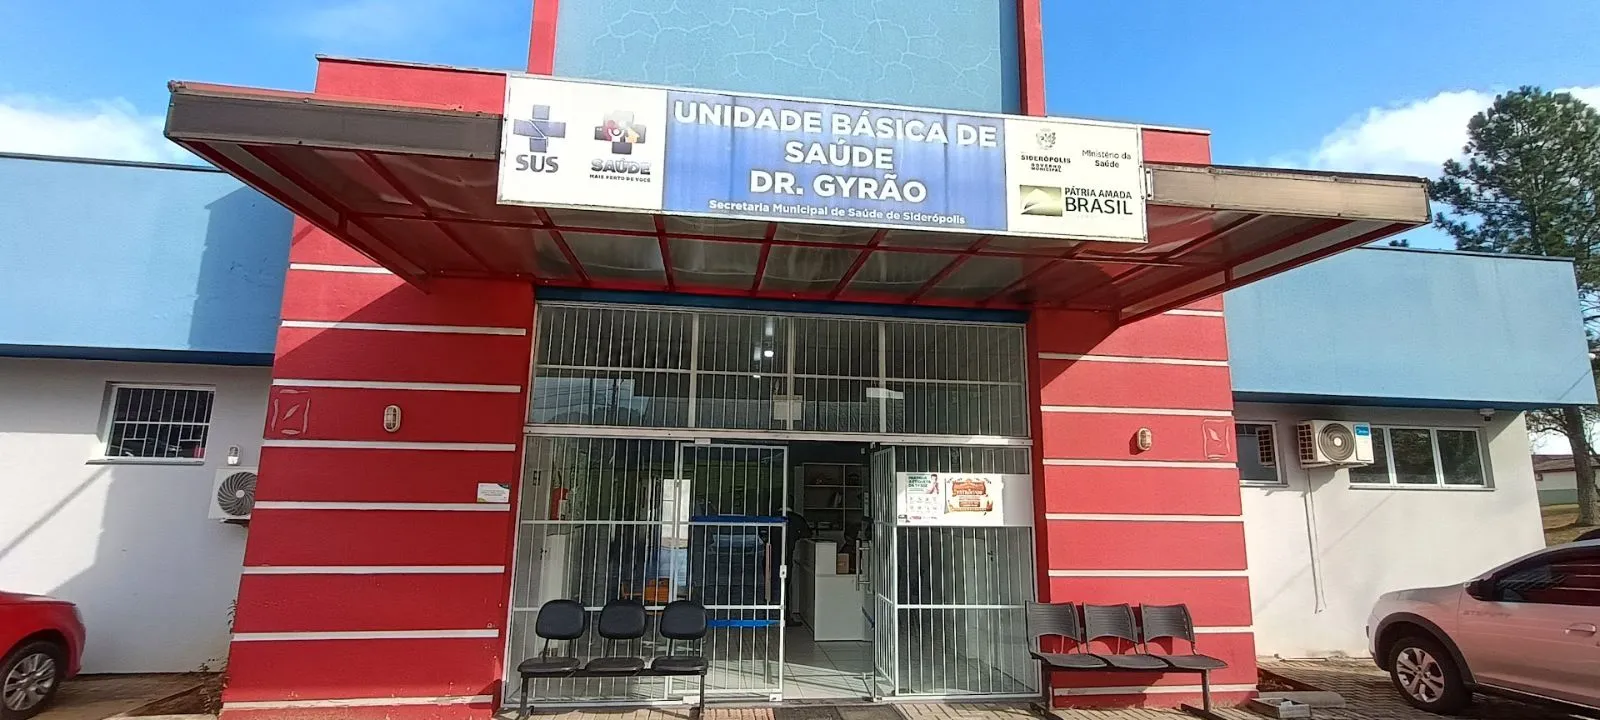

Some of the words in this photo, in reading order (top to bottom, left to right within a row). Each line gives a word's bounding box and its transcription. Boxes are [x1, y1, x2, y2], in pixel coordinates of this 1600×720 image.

[674, 101, 822, 133] UNIDADE
[831, 109, 949, 144] BÁSICA
[957, 123, 997, 148] DE
[515, 154, 559, 173] SUS
[784, 138, 894, 170] SAÚDE
[1021, 154, 1071, 164] SIDERÓPOLIS
[1082, 149, 1120, 160] Ministério
[1121, 152, 1132, 160] da
[1095, 159, 1120, 168] Saúde
[591, 157, 651, 175] SAÚDE
[750, 169, 805, 195] DR.
[812, 173, 927, 203] GYRÃO
[1064, 186, 1097, 197] PÁTRIA
[1098, 189, 1132, 200] AMADA
[709, 200, 770, 212] Secretaria
[773, 203, 828, 216] Municipal
[831, 207, 846, 217] de
[848, 208, 883, 219] Saúde
[886, 211, 901, 221] de
[903, 212, 966, 225] Siderópolis
[1065, 196, 1133, 216] BRASIL
